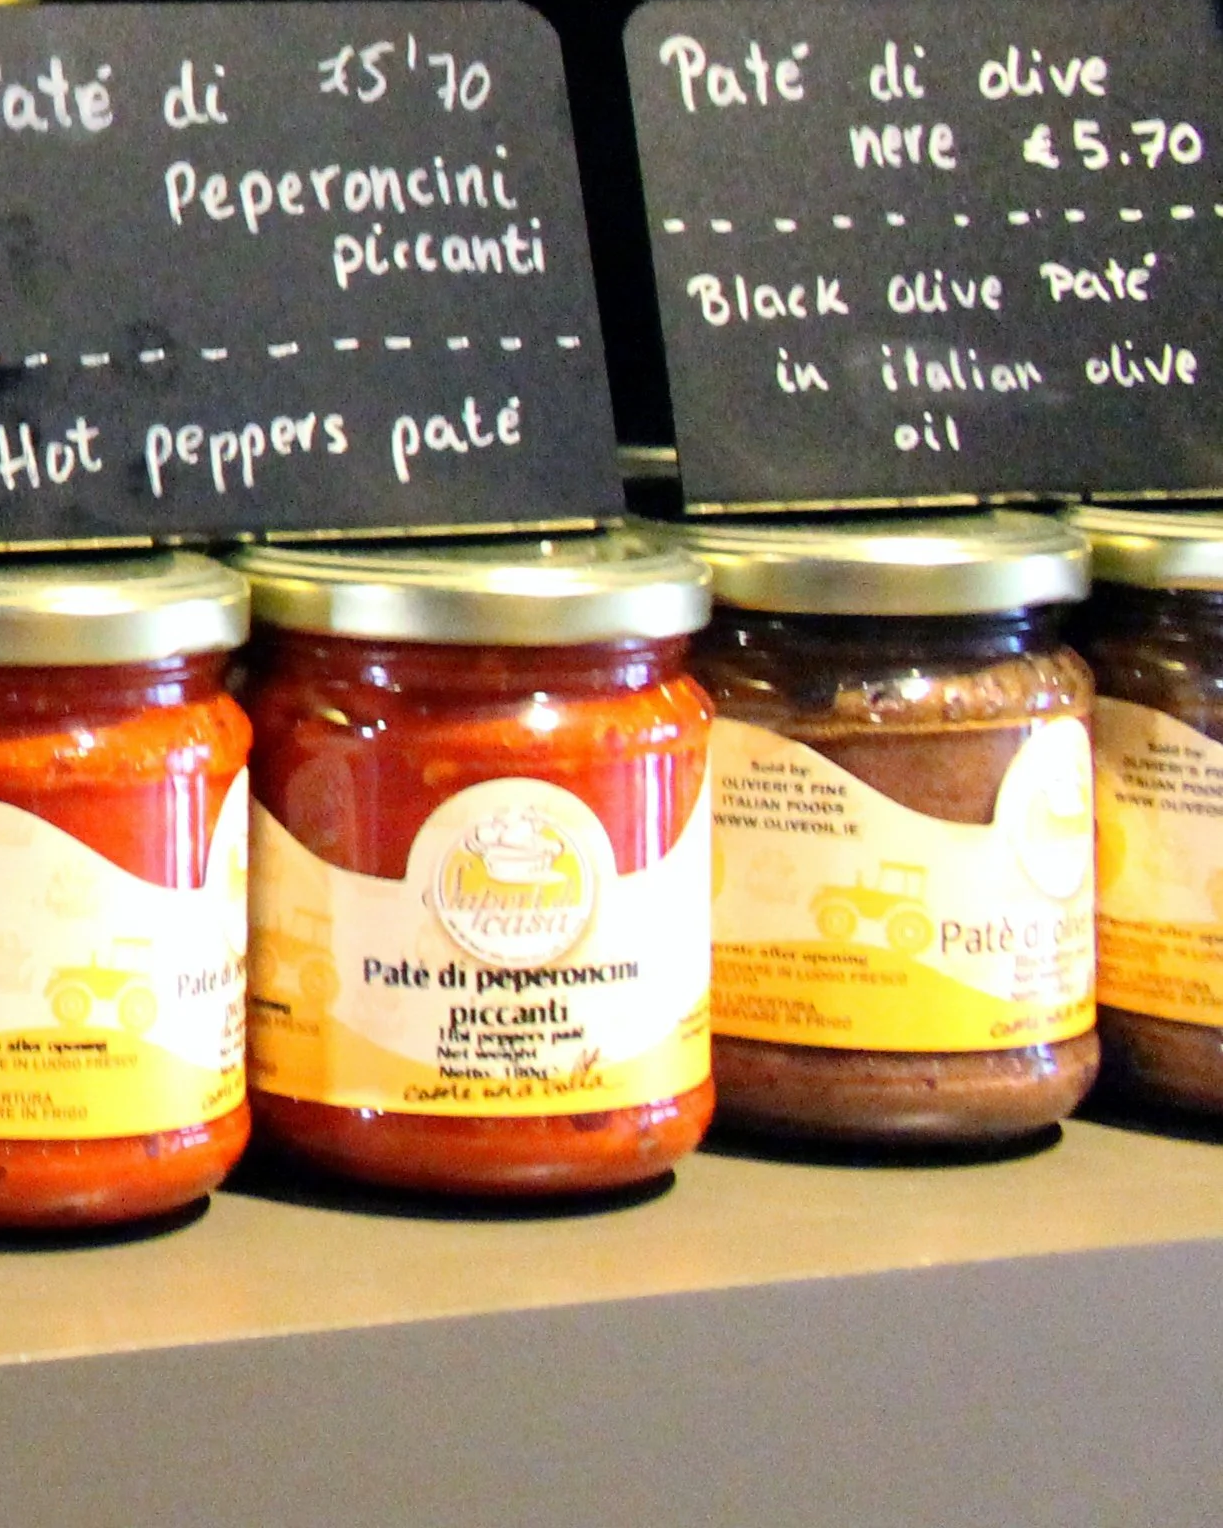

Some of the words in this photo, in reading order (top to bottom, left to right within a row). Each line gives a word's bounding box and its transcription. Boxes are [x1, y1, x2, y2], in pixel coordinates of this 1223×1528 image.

[163, 60, 228, 128] di
[869, 40, 926, 102] di
[979, 45, 1109, 100] olive
[848, 121, 957, 171] nere
[686, 273, 850, 327] Black
[777, 348, 830, 394] in
[881, 345, 1044, 395] italian
[1086, 341, 1198, 388] olive
[145, 411, 348, 497] peppers
[894, 411, 961, 453] oil
[722, 794, 781, 811] ITALIAN
[438, 961, 466, 988] di
[476, 961, 639, 994] peperoncini
[450, 998, 568, 1027] piccanti
[438, 1045, 469, 1060] Net
